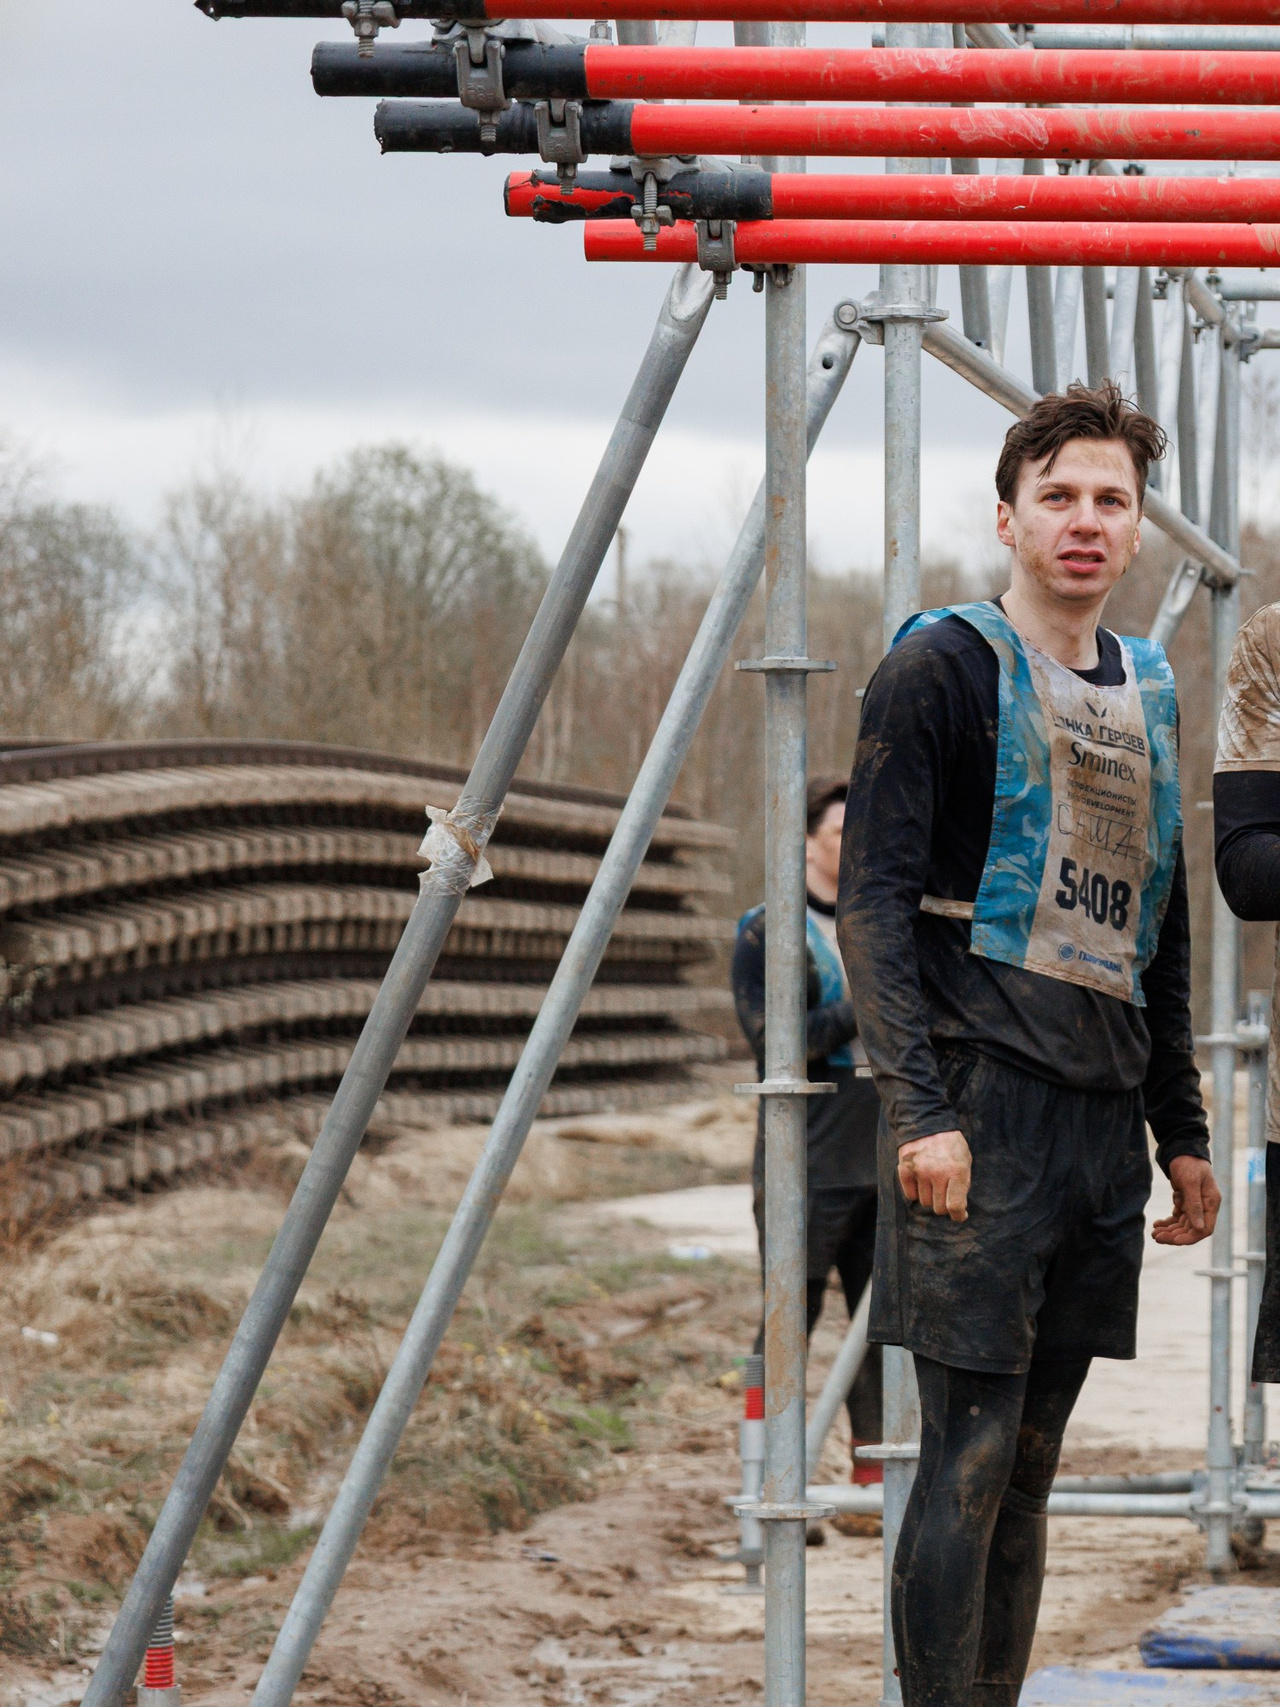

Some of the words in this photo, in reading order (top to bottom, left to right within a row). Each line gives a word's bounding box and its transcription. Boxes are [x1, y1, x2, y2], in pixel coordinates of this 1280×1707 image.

[1098, 724, 1146, 751] ГЕРОЕВ
[1068, 741, 1137, 785] Sminex
[1055, 856, 1132, 931] 5408
